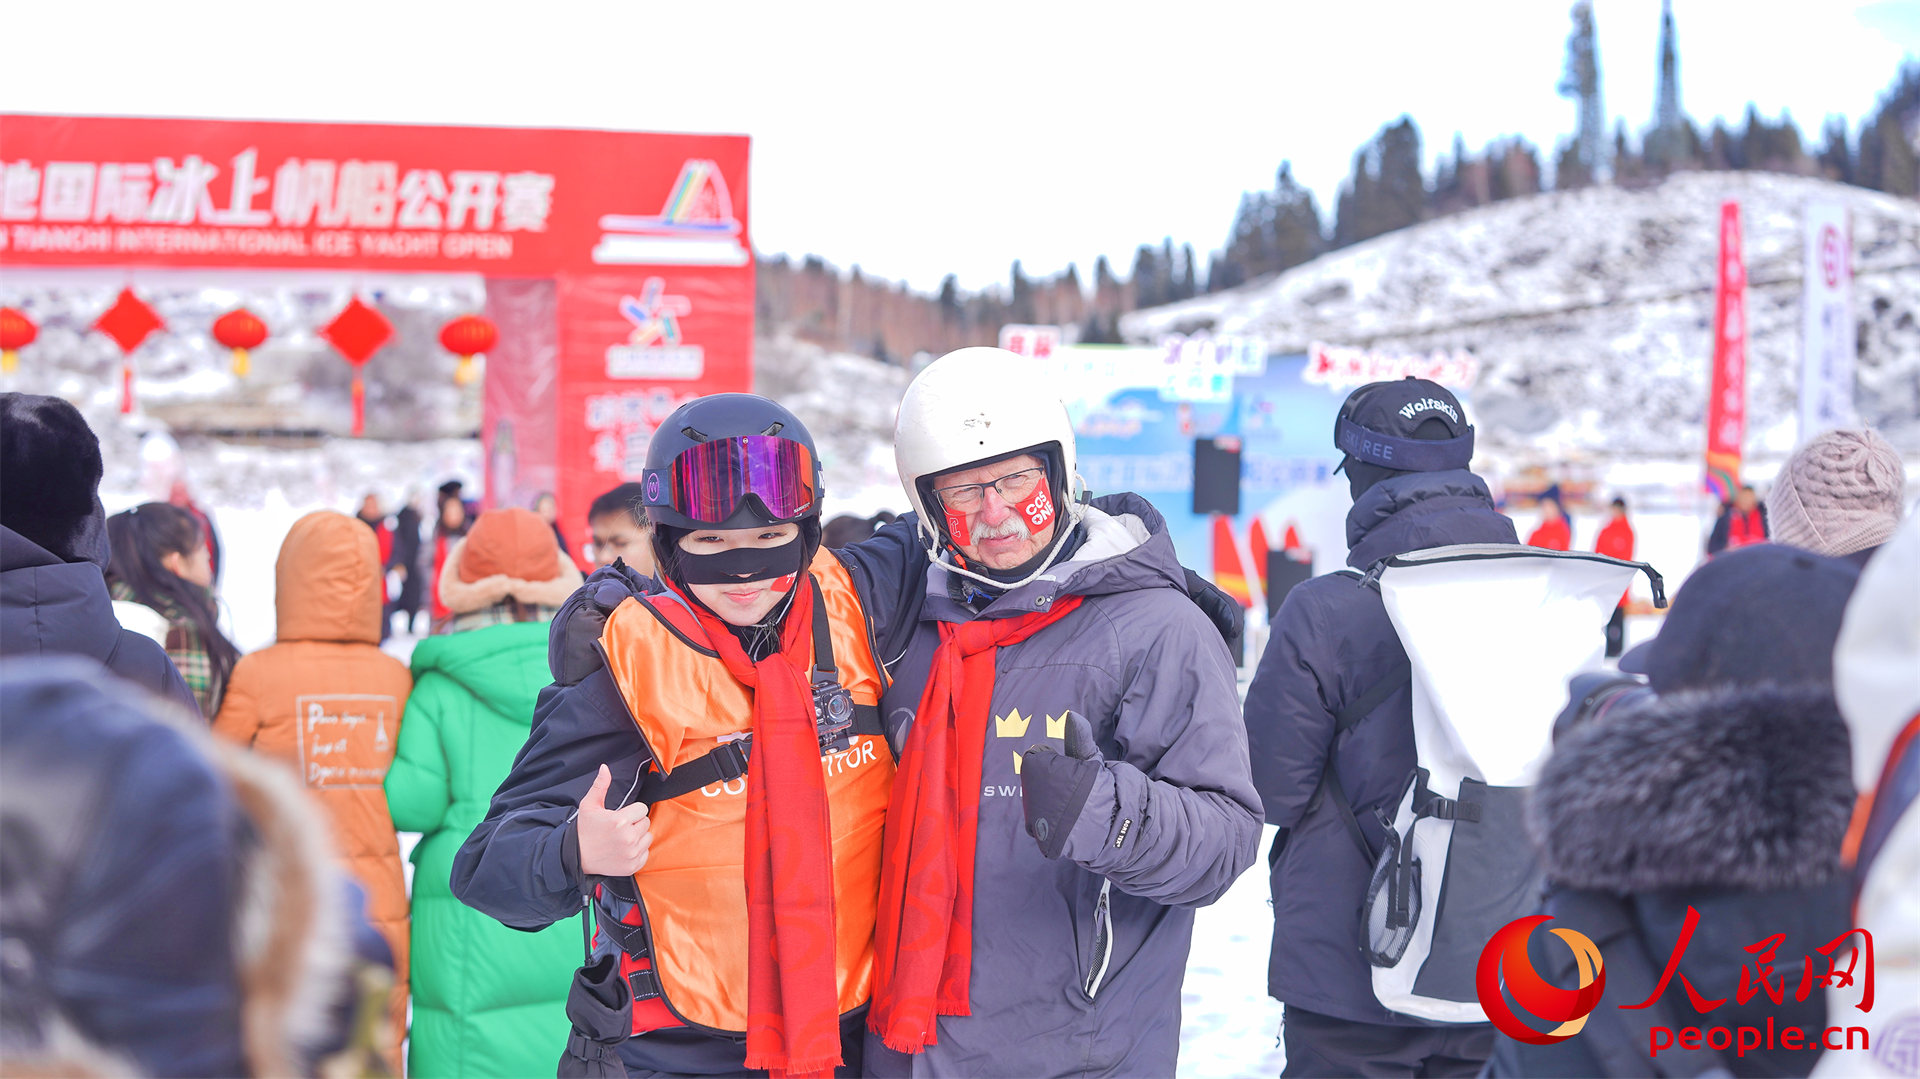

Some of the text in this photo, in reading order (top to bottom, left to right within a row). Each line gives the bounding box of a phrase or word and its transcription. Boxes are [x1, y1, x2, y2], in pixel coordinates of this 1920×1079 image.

[118, 227, 309, 255] INTERNATIONAL
[311, 231, 356, 256] ICE
[359, 232, 440, 257] YACHT
[442, 234, 514, 259] OPEN
[1399, 398, 1459, 424] Wolfskin
[1025, 491, 1047, 515] COS
[1031, 500, 1054, 525] ONE
[984, 786, 1023, 797] SW
